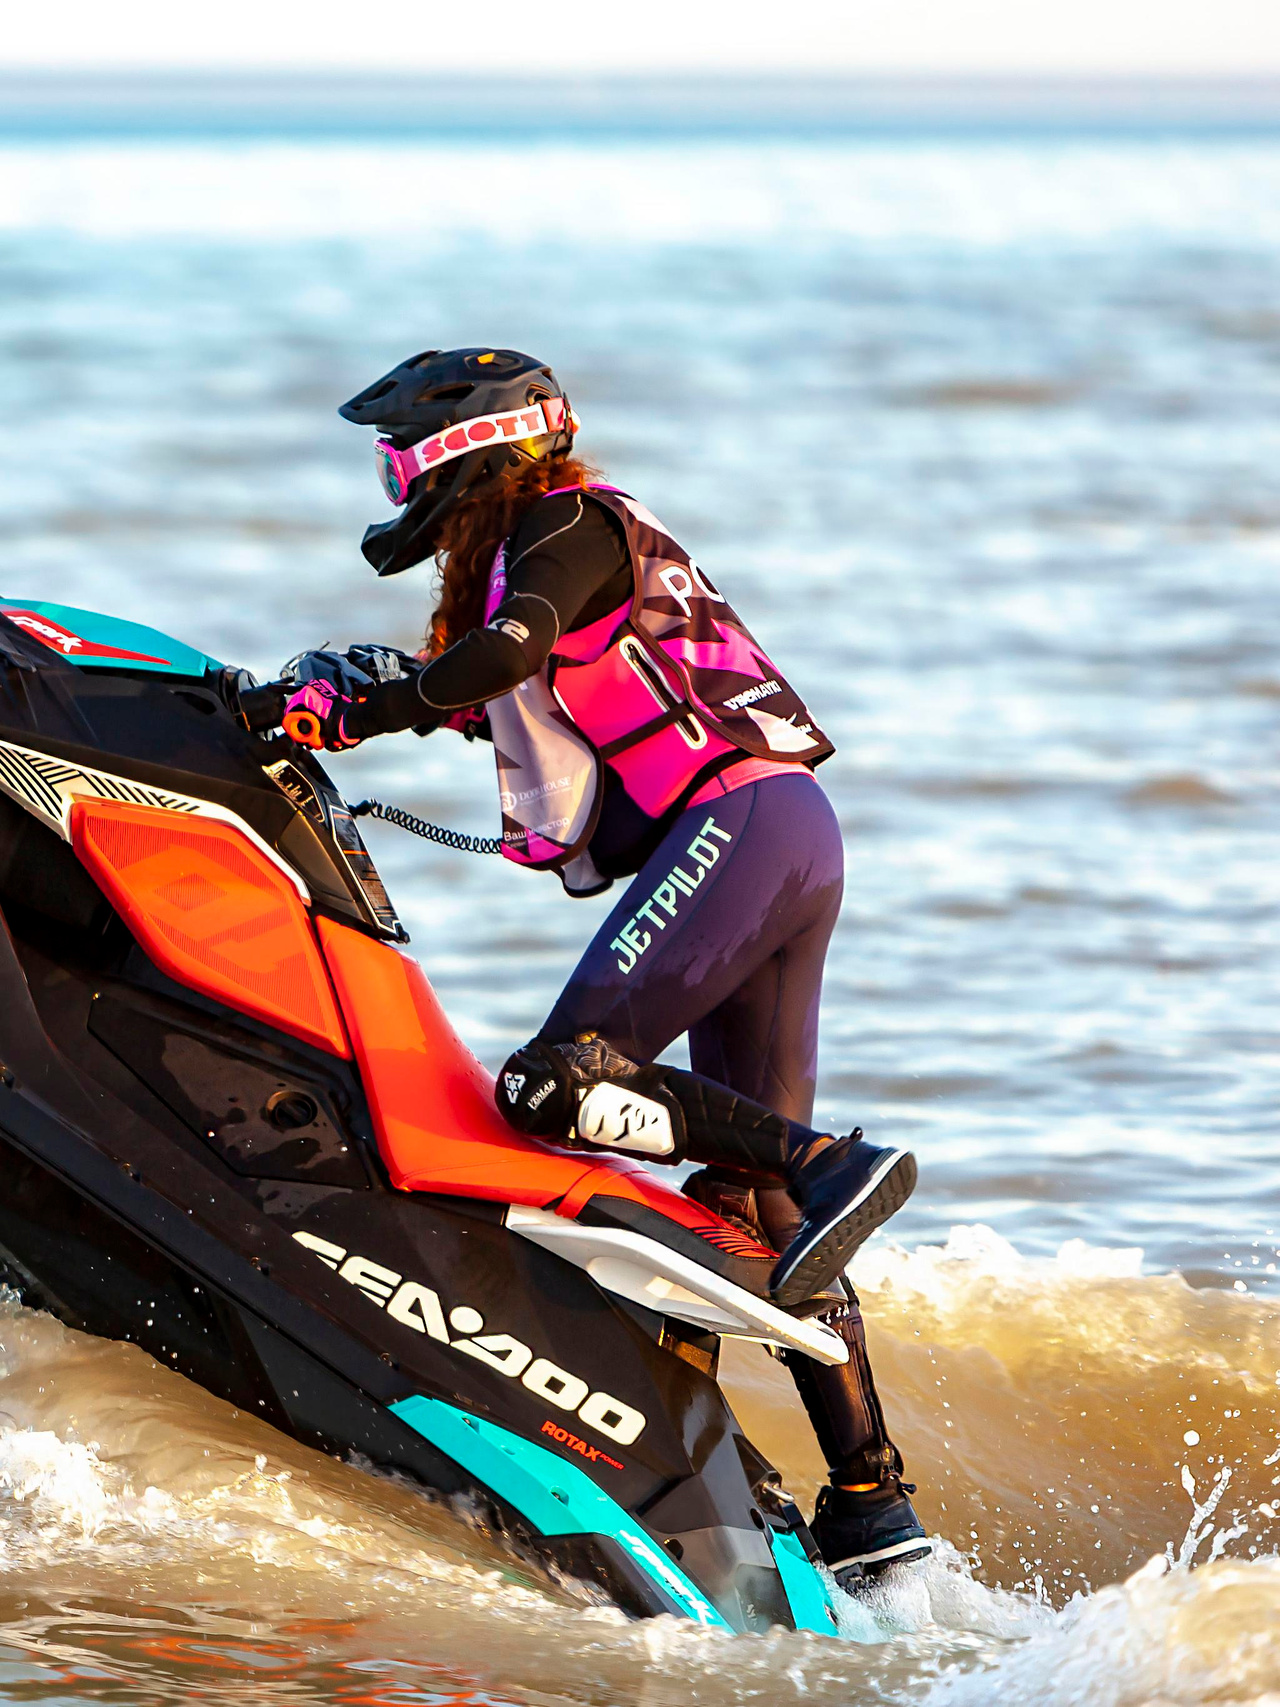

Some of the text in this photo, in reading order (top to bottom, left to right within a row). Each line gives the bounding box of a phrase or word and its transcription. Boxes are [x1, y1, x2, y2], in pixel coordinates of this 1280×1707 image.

[422, 411, 540, 464] SCOTT
[609, 816, 733, 975] JETPILOT
[541, 1420, 625, 1470] ROTAX POWER
